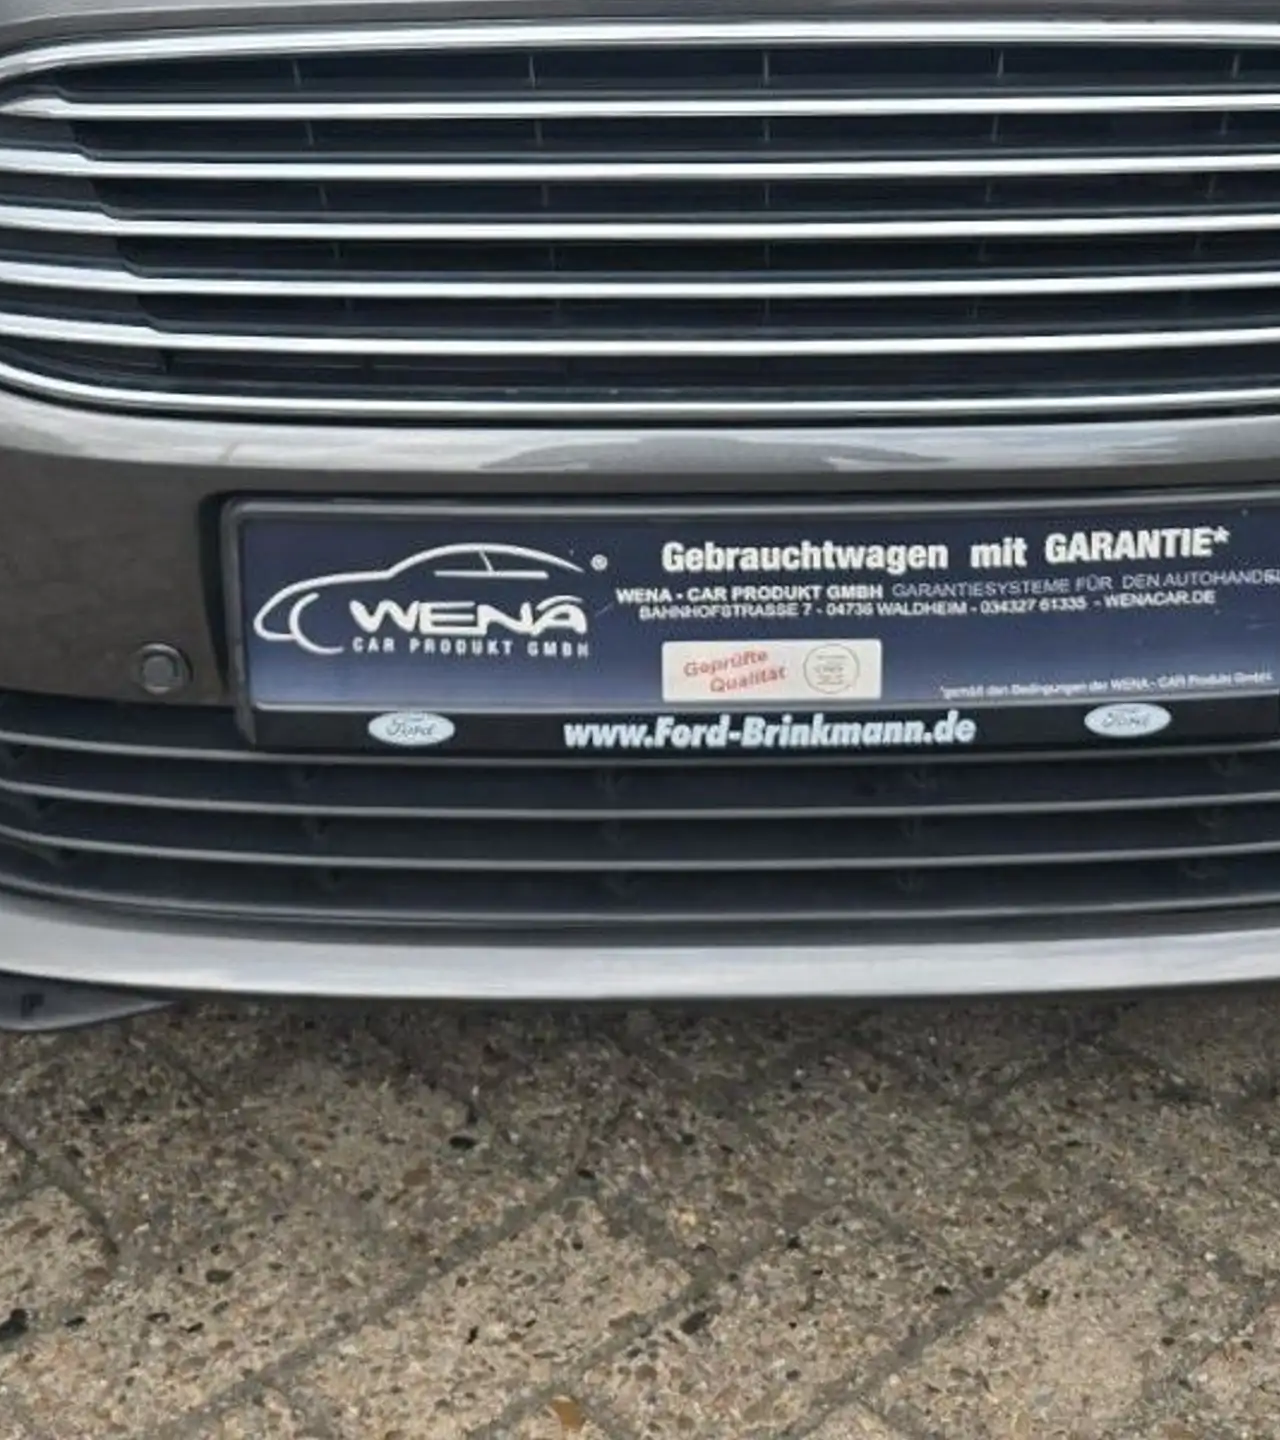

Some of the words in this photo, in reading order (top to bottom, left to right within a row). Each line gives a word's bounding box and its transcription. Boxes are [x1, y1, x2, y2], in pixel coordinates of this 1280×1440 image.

[661, 539, 949, 575] Gebrauchtwagen
[970, 536, 1028, 568] mit
[615, 587, 673, 604] WENA
[686, 586, 728, 602] CAR
[731, 585, 822, 601] PRODUKT
[826, 584, 884, 601] GMBH
[1122, 572, 1160, 590] DEN
[349, 594, 588, 637] WENA
[638, 602, 800, 621] BAHNHOFSTRASSE
[802, 601, 812, 616] 7
[875, 600, 968, 617] WALDHEIM
[352, 637, 395, 653] CAR
[409, 638, 514, 656] PRODUKT
[526, 639, 590, 658] GMBH
[563, 709, 978, 749] www.Ford-Brinkmann.de
